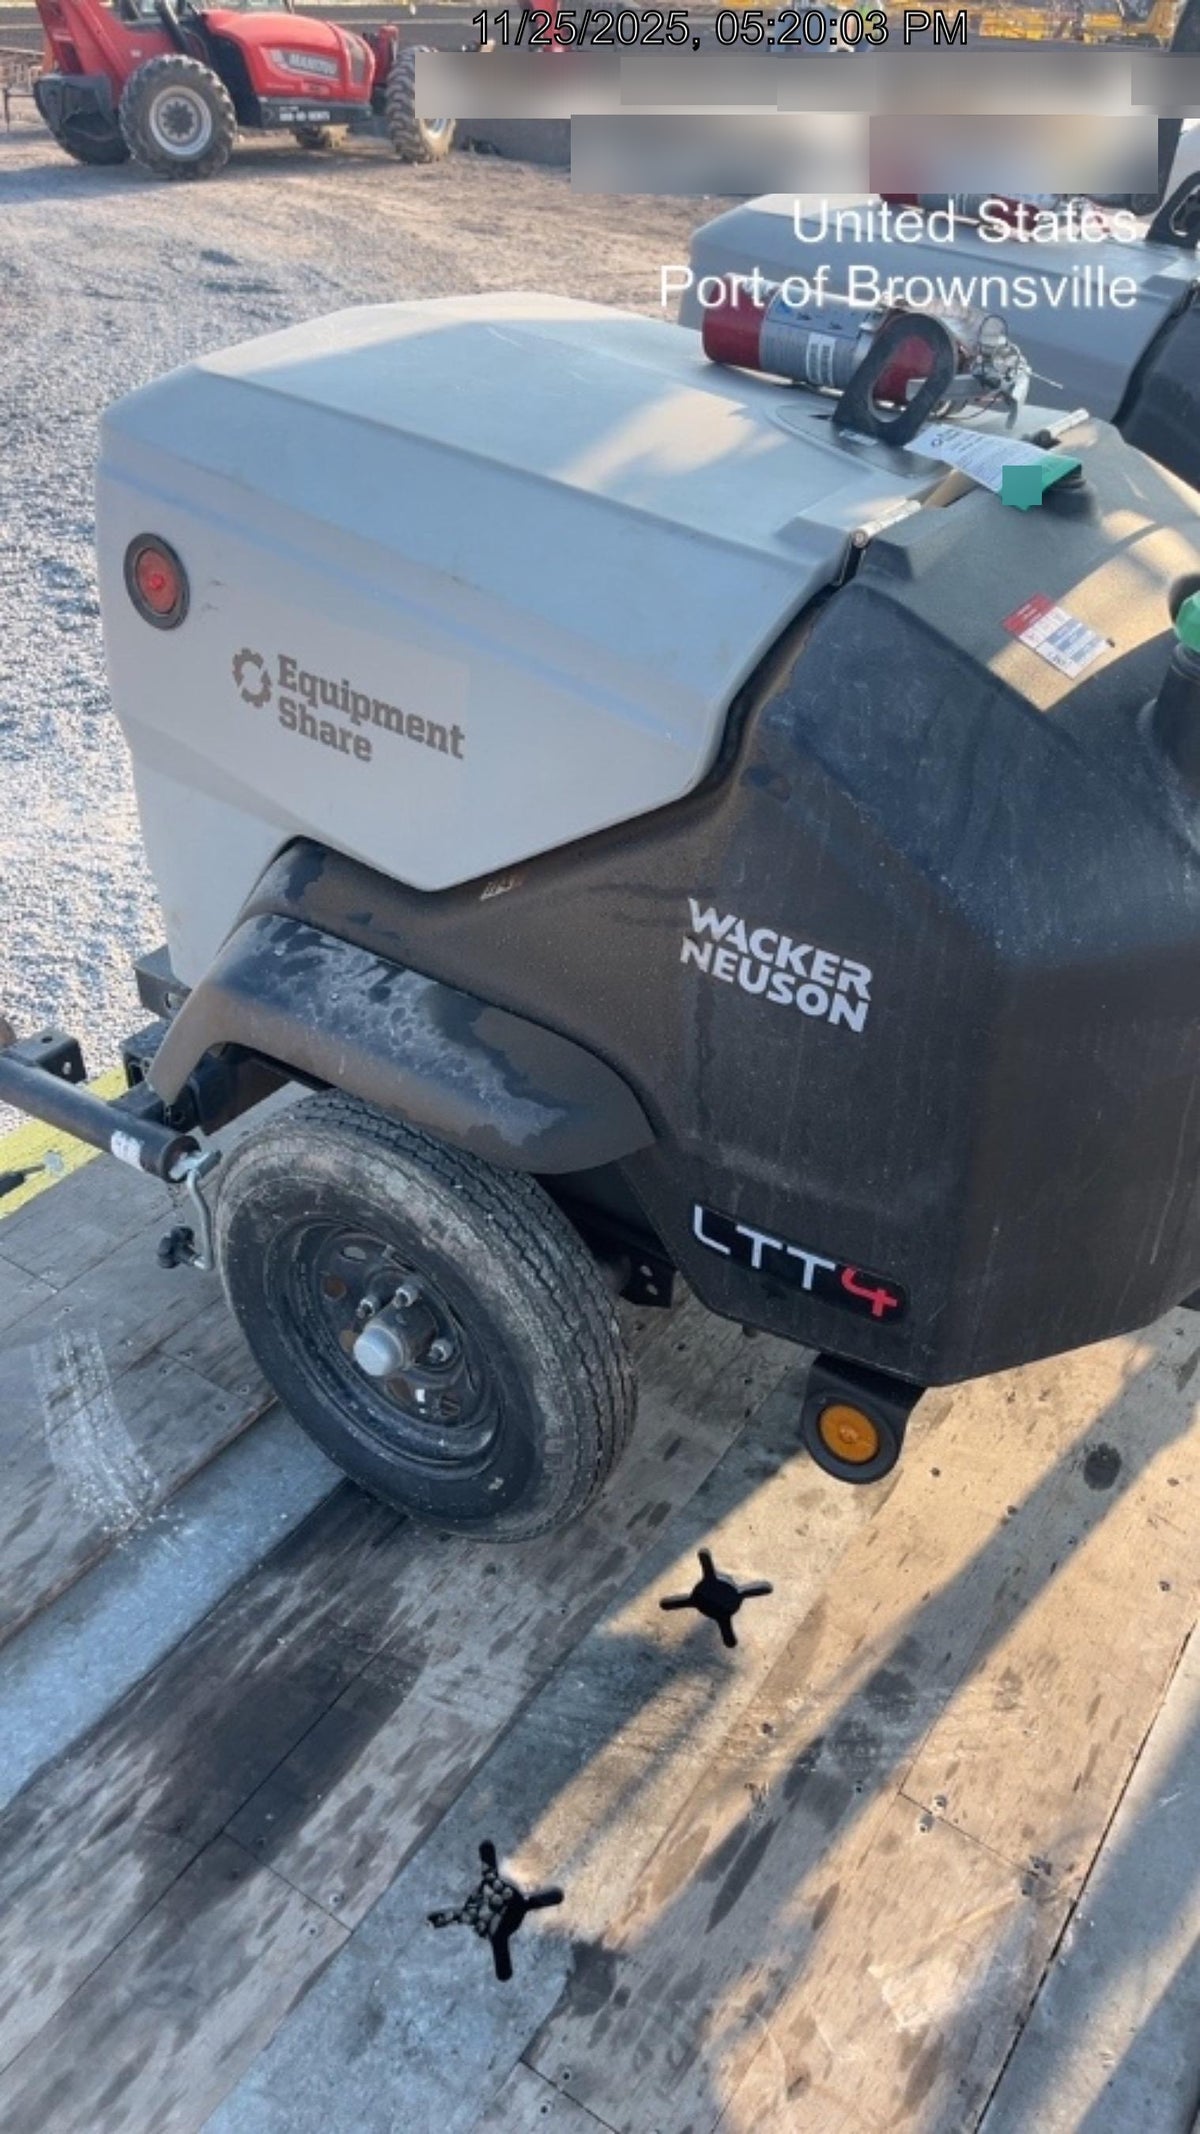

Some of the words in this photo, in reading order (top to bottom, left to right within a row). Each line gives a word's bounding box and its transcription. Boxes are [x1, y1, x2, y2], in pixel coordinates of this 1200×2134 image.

[277, 654, 465, 760] Equipment
[278, 698, 372, 761] Share
[681, 936, 869, 1033] NEUSON
[688, 898, 873, 1001] WACKER
[693, 1204, 898, 1317] LTT4
